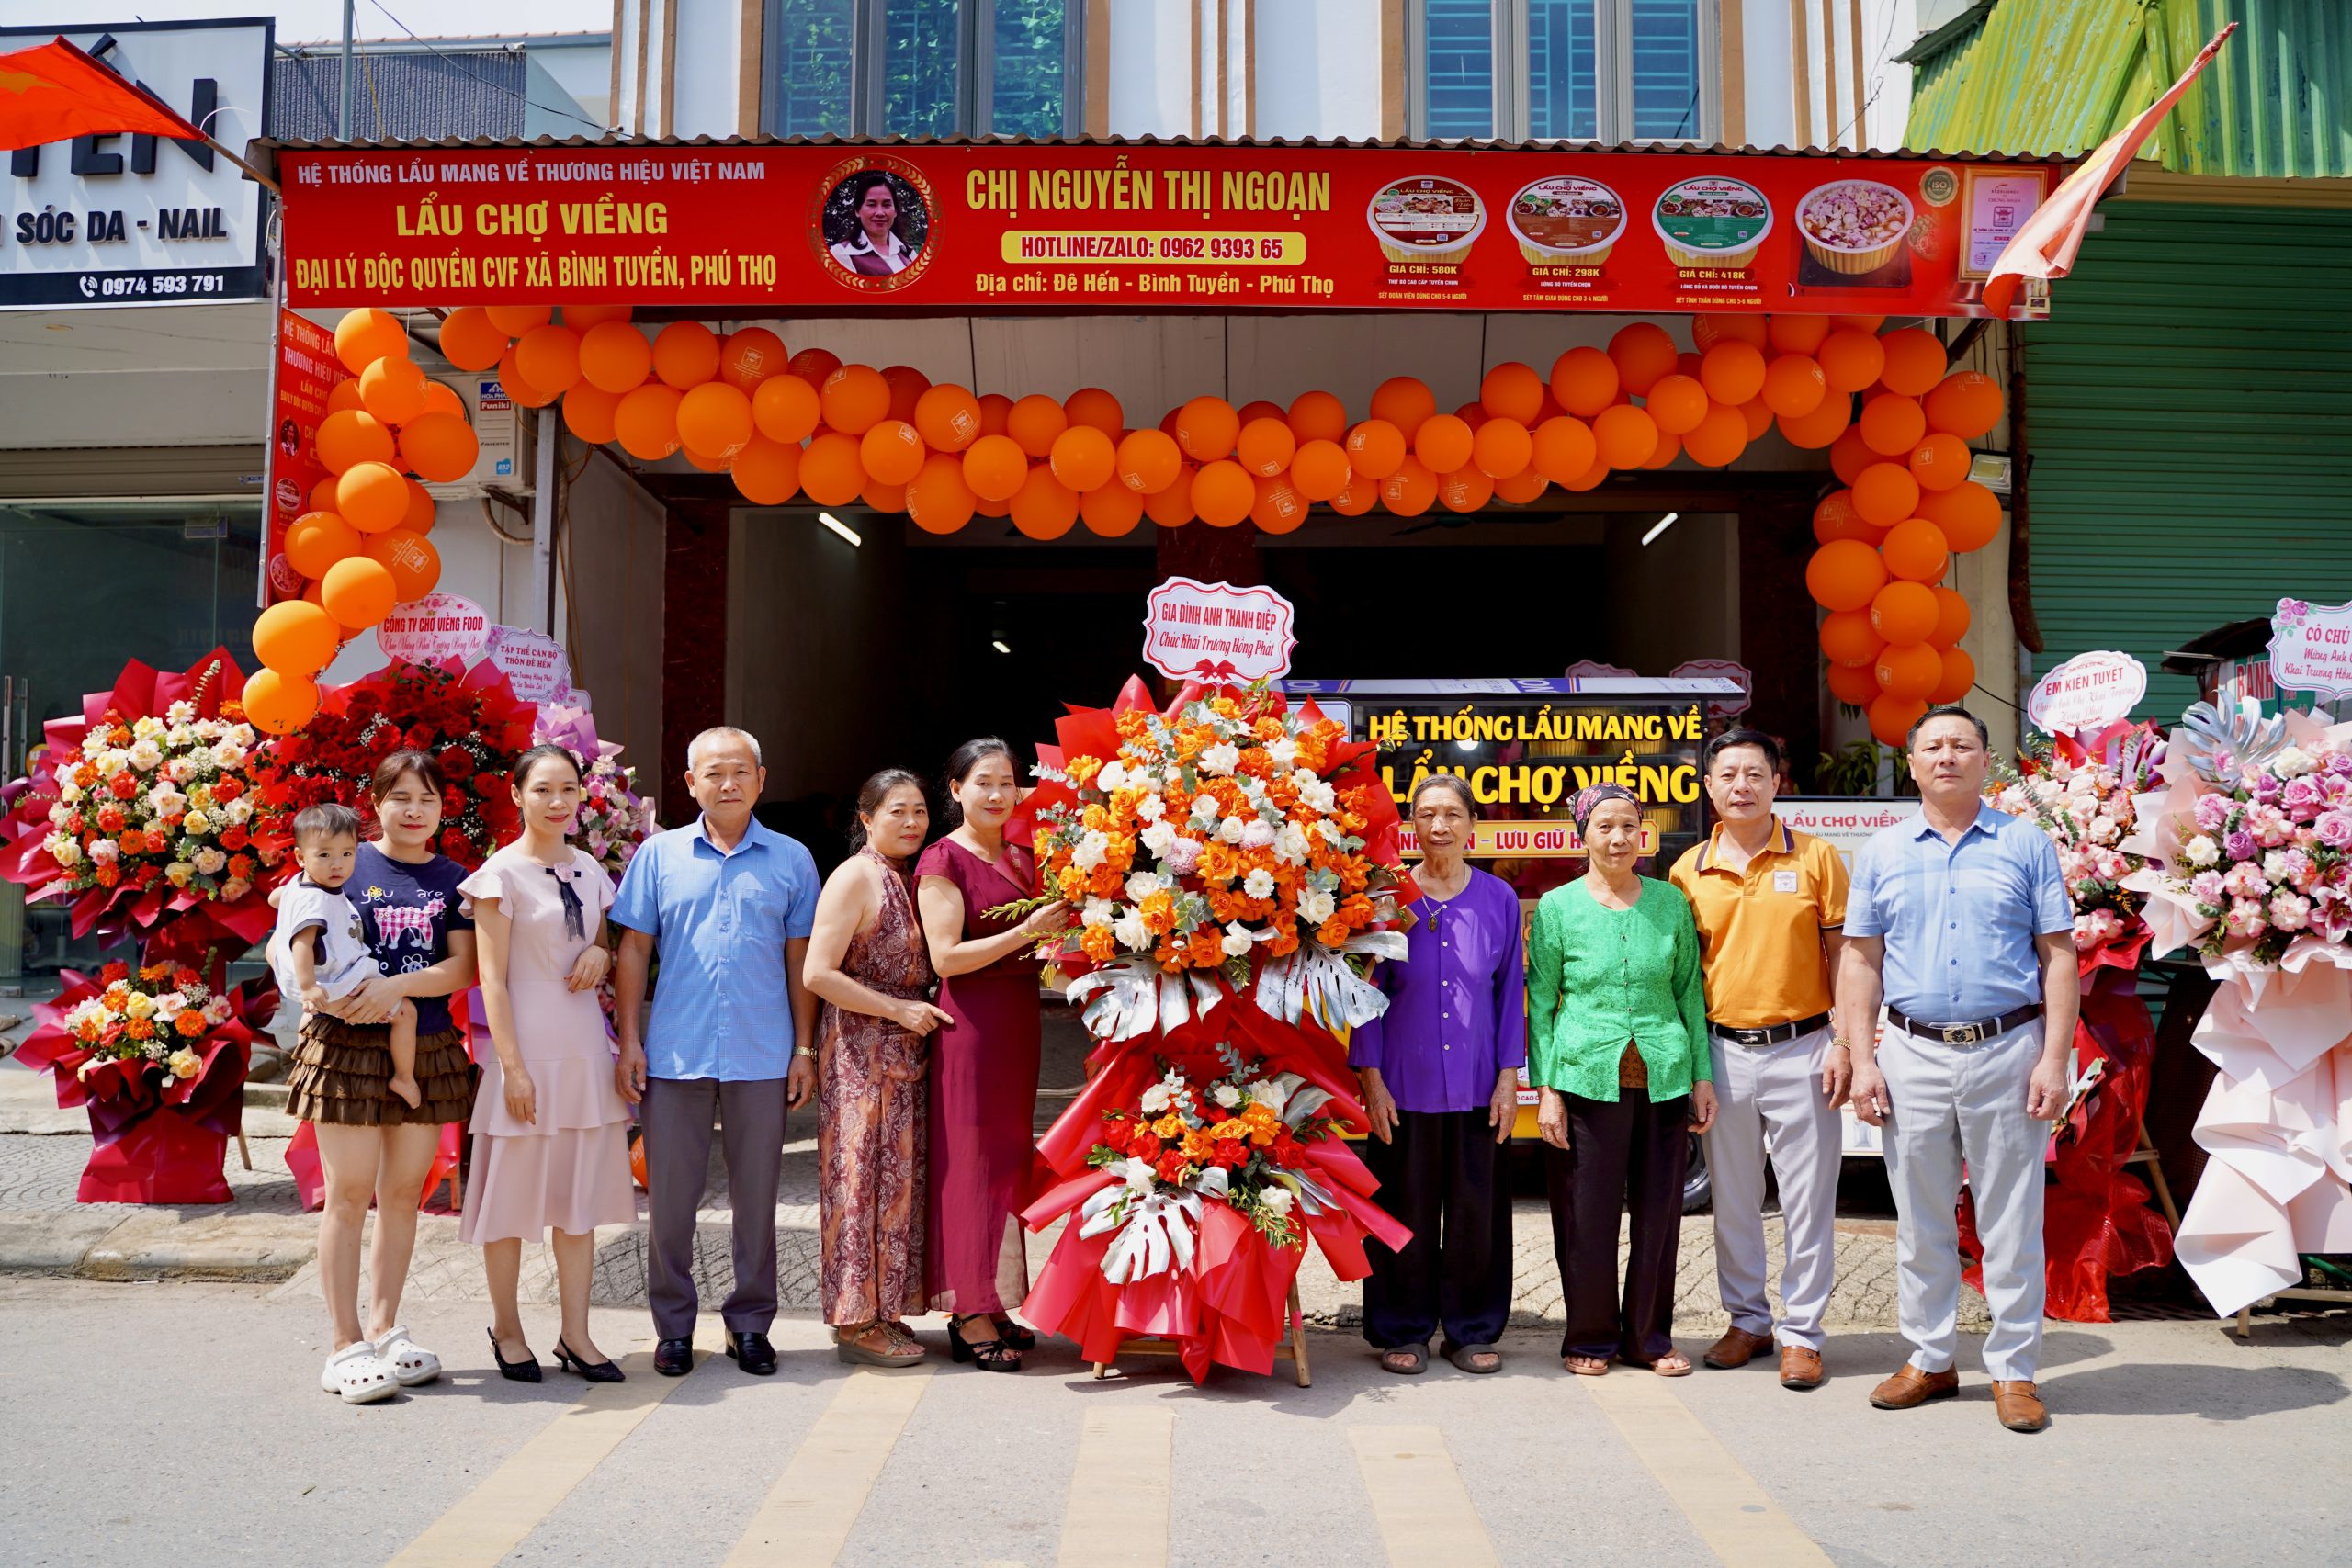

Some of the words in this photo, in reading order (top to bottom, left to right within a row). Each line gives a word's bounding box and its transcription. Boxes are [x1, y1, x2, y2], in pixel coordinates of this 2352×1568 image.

[298, 163, 322, 187] HỆ
[328, 159, 391, 183] THỐNG
[398, 157, 435, 183] LẨU
[441, 164, 500, 182] MANG
[505, 157, 529, 182] VỀ
[535, 161, 614, 181] THƯƠNG
[620, 159, 664, 184] HIỆU
[671, 158, 712, 184] VIỆT
[718, 162, 765, 180] NAM
[967, 169, 1017, 218] CHỊ
[1028, 154, 1153, 209] NGUYỄN
[1163, 170, 1211, 219] THỊ
[1222, 171, 1330, 220] NGOẠN
[16, 205, 75, 244] SÓC
[87, 210, 127, 243] DA
[137, 220, 148, 229] -
[158, 207, 228, 240] NAIL
[396, 191, 463, 236] LẨU
[476, 200, 548, 242] CHỢ
[559, 192, 668, 234] VIỀNG
[1020, 235, 1155, 258] HOTLINE/ZALO:
[1159, 236, 1205, 259] 0962
[1210, 237, 1255, 259] 9393
[1260, 238, 1283, 260] 65
[295, 258, 329, 295] ĐẠI
[334, 252, 357, 288] LÝ
[364, 252, 404, 295] ĐỘC
[411, 247, 476, 291] QUYỀN
[482, 256, 519, 287] CVF
[526, 250, 553, 287] XÃ
[559, 250, 607, 287] BÌNH
[614, 245, 684, 289] TUYỀN,
[691, 249, 731, 286] PHÚ
[738, 254, 777, 292] THỌ
[1432, 265, 1457, 275] 580K
[1575, 268, 1600, 276] 298K
[1721, 271, 1745, 279] 418K
[102, 278, 147, 296] 0974
[153, 277, 187, 295] 593
[191, 275, 224, 293] 791
[976, 273, 1006, 296] Địa
[1012, 271, 1047, 292] chỉ:
[1054, 273, 1078, 292] Đê
[1084, 270, 1119, 292] Hến
[1139, 273, 1181, 292] Bình
[1187, 271, 1239, 295] Tuyền
[1260, 275, 1295, 294] Phú
[1301, 275, 1334, 299] Thọ
[284, 318, 294, 342] HỆ
[296, 324, 321, 351] THỐNG
[284, 346, 313, 374] THƯƠNG
[481, 401, 510, 410] Funiki
[497, 463, 510, 471] R32
[384, 615, 405, 633] CÔNG
[408, 617, 418, 632] TY
[419, 616, 436, 635] CHỢ
[463, 616, 483, 631] FOOD
[1161, 602, 1177, 622] GIA
[1179, 601, 1202, 625] ĐÌNH
[1203, 606, 1223, 626] ANH
[1226, 608, 1254, 630] THANH
[1256, 609, 1276, 636] ĐIỆP
[2306, 623, 2322, 642] CÔ
[2325, 626, 2350, 644] CHÚ
[501, 644, 514, 655] TẬP
[532, 648, 547, 658] CÁN
[548, 649, 558, 660] BỘ
[505, 657, 525, 666] THÔN
[2046, 681, 2062, 696] EM
[2236, 655, 2275, 703] BÁNH
[1370, 709, 1408, 748] HỆ
[1412, 704, 1514, 741] THỐNG
[1517, 704, 1574, 741] LẨU
[1577, 715, 1663, 741] MANG
[1666, 704, 1702, 740] VỀ
[1382, 749, 1466, 804] LẨ
[1472, 764, 1565, 812] CHỢ
[1782, 810, 1816, 828] LẨU
[1821, 814, 1857, 829] CHỢ
[1860, 809, 1909, 828] VIỀN
[1496, 831, 1530, 850] LƯU
[1533, 829, 1566, 850] GIỮ
[416, 889, 446, 898] are
